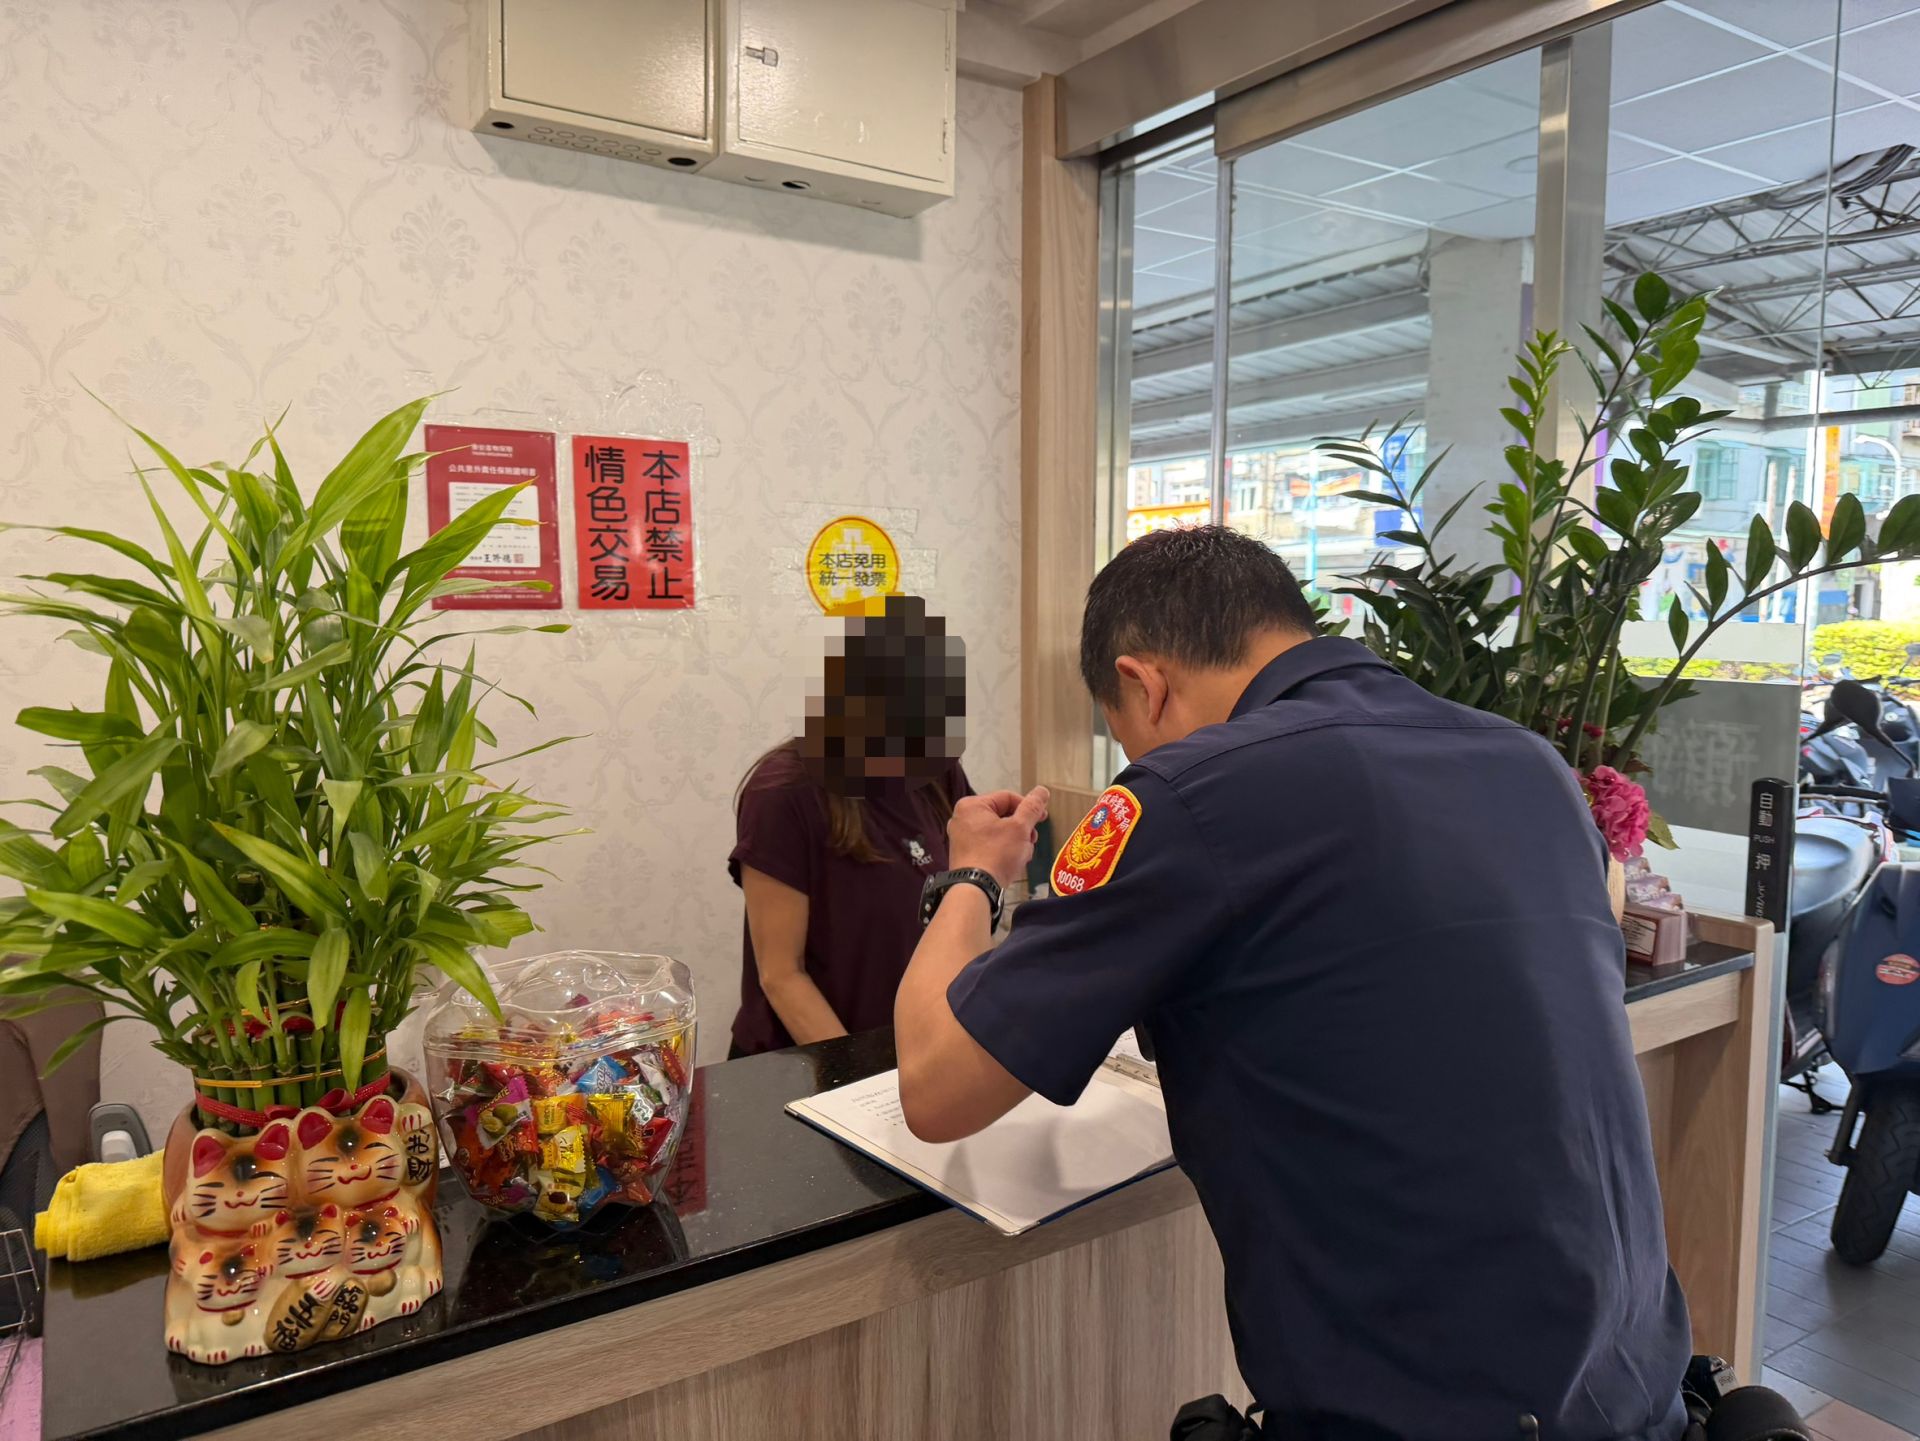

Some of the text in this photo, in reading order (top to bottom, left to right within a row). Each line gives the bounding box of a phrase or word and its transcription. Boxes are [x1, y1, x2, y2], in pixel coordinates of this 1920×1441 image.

[584, 445, 630, 601] 情色交易
[642, 450, 684, 600] 本店禁止
[818, 552, 887, 569] 本店免用
[818, 570, 887, 587] 統一發票
[1056, 869, 1085, 892] 10068
